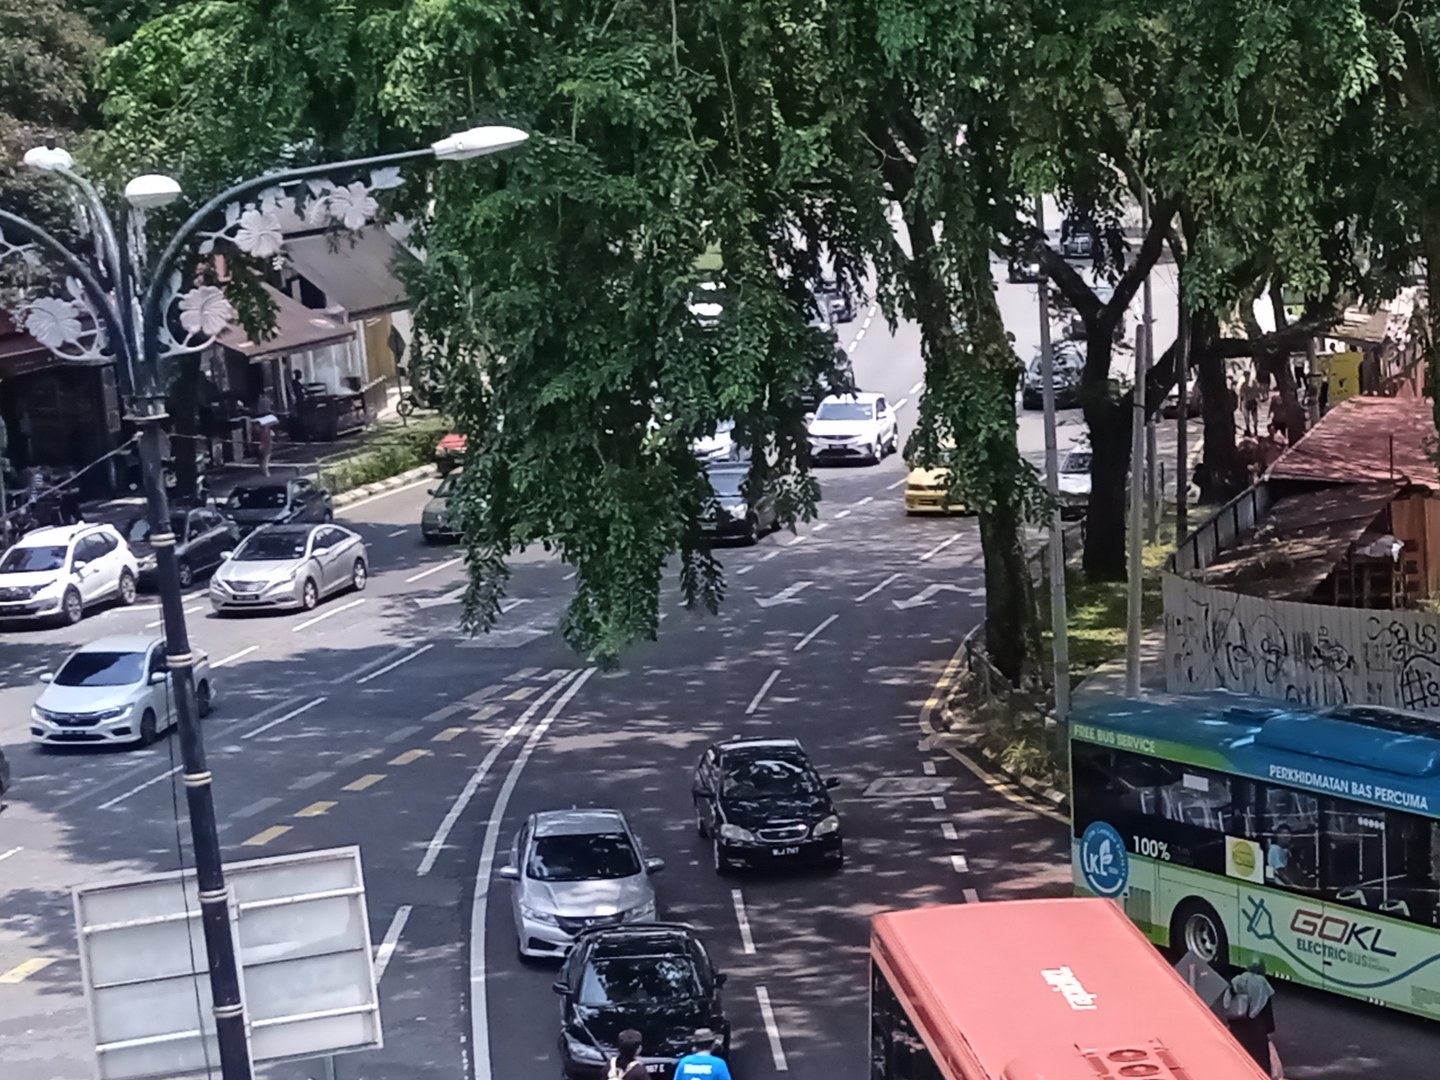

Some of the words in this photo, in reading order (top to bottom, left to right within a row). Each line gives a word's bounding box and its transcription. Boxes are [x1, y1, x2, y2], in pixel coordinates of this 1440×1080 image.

[1074, 724, 1095, 741] FREE
[1097, 729, 1115, 745] BUS
[1116, 733, 1156, 753] SERVICE
[1269, 764, 1349, 793] PERKHIDMATAN
[1351, 782, 1373, 798] BAS
[1374, 786, 1429, 810] PERCUMA
[1133, 835, 1171, 860] 100%
[1290, 909, 1397, 957] GOKL
